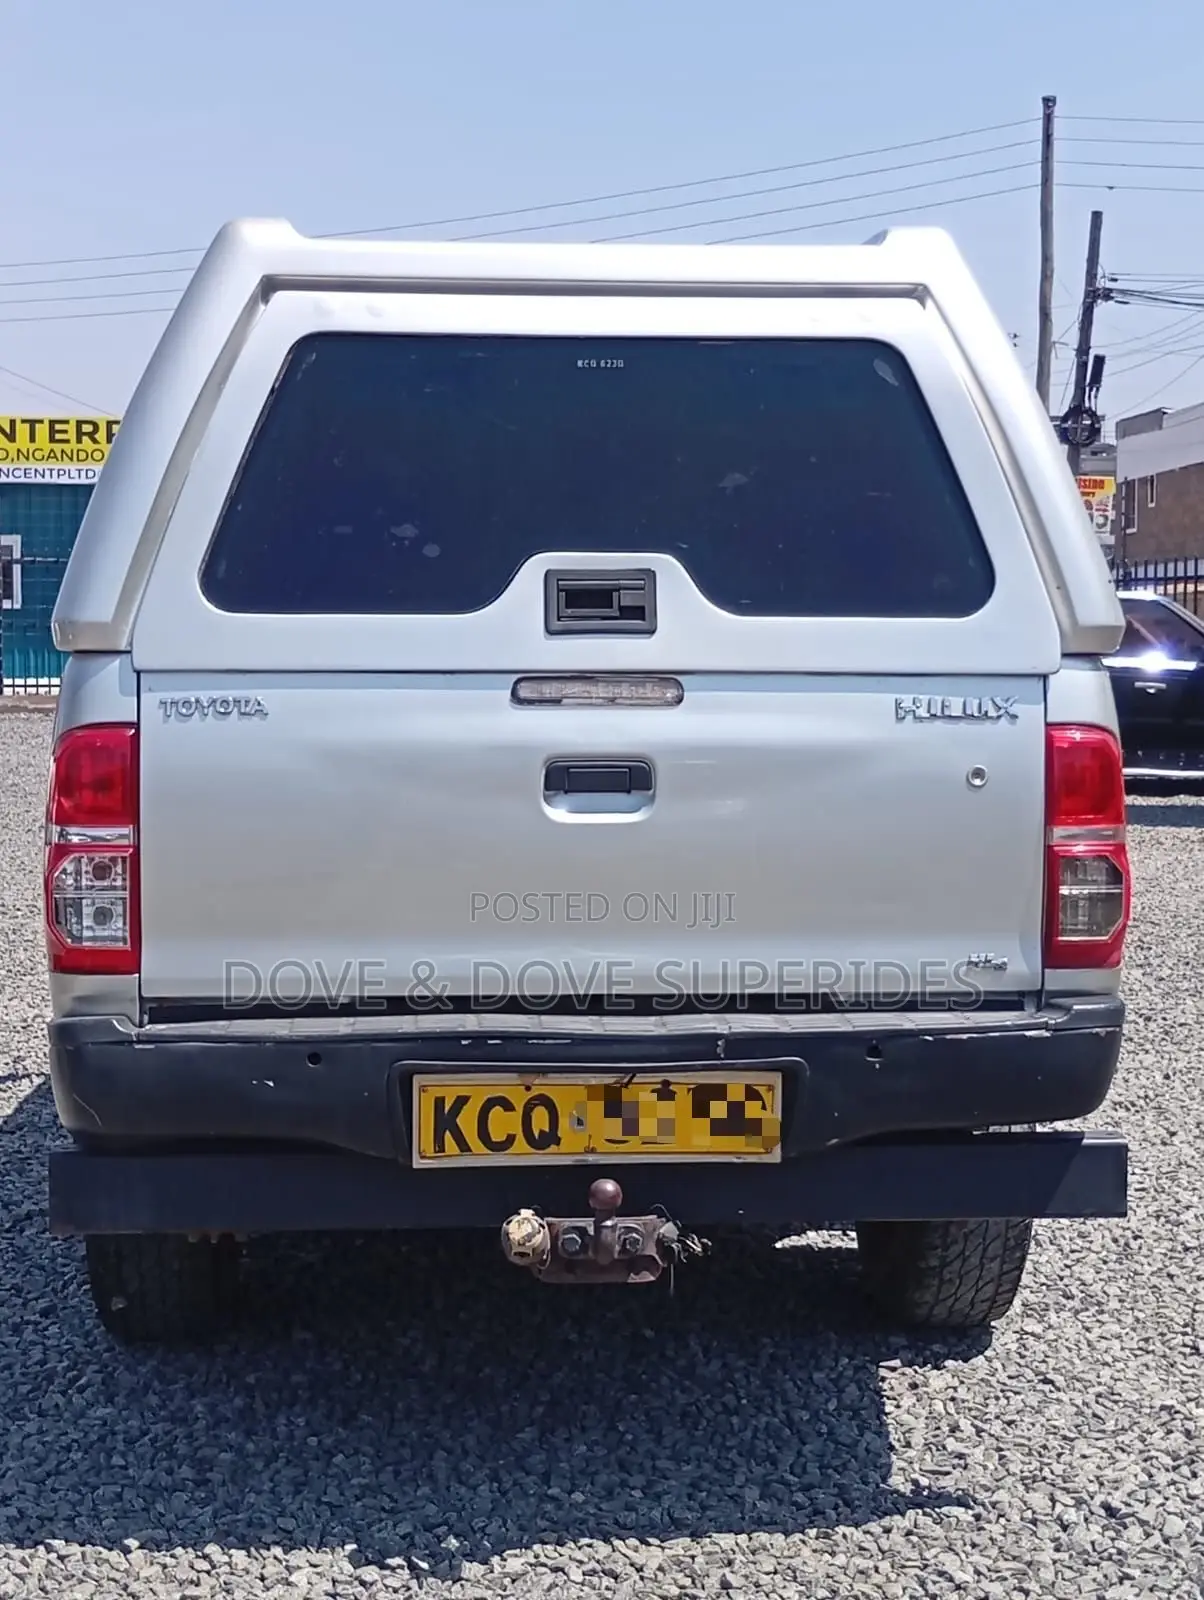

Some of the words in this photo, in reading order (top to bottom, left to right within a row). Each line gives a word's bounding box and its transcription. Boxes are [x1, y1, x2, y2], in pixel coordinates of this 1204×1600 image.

[159, 695, 269, 718] TOYOTA
[895, 696, 1019, 721] HILUX
[432, 1093, 563, 1154] KCQ
